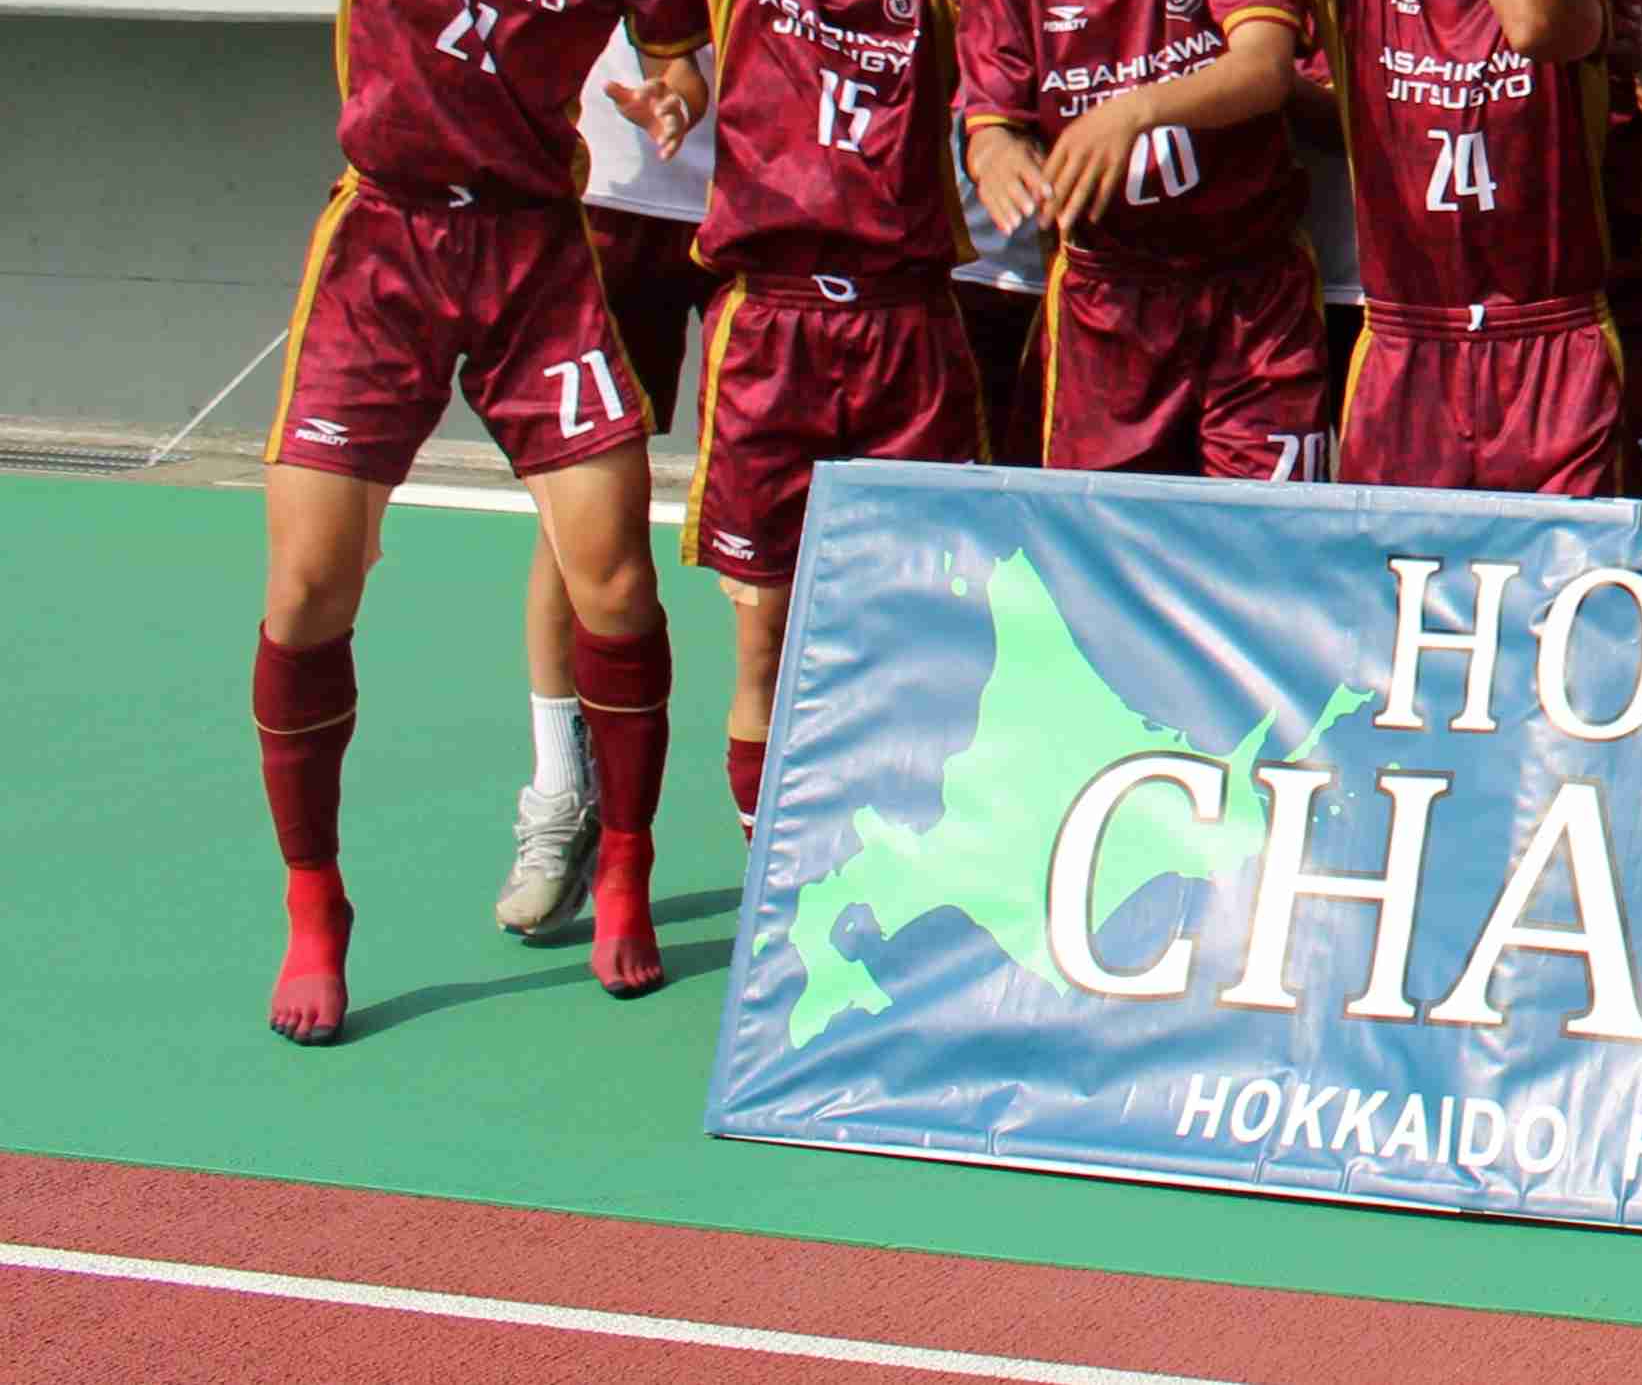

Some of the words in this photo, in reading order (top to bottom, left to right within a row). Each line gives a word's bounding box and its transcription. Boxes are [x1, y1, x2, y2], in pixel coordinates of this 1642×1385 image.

[1039, 30, 1222, 92] ASAHIKAWA
[816, 66, 879, 152] 15
[1124, 124, 1200, 207] 20
[1424, 127, 1498, 213] 24
[294, 427, 350, 447] PENALTY
[543, 348, 626, 440] 21
[1176, 1075, 1569, 1174] HOKKAIDO
